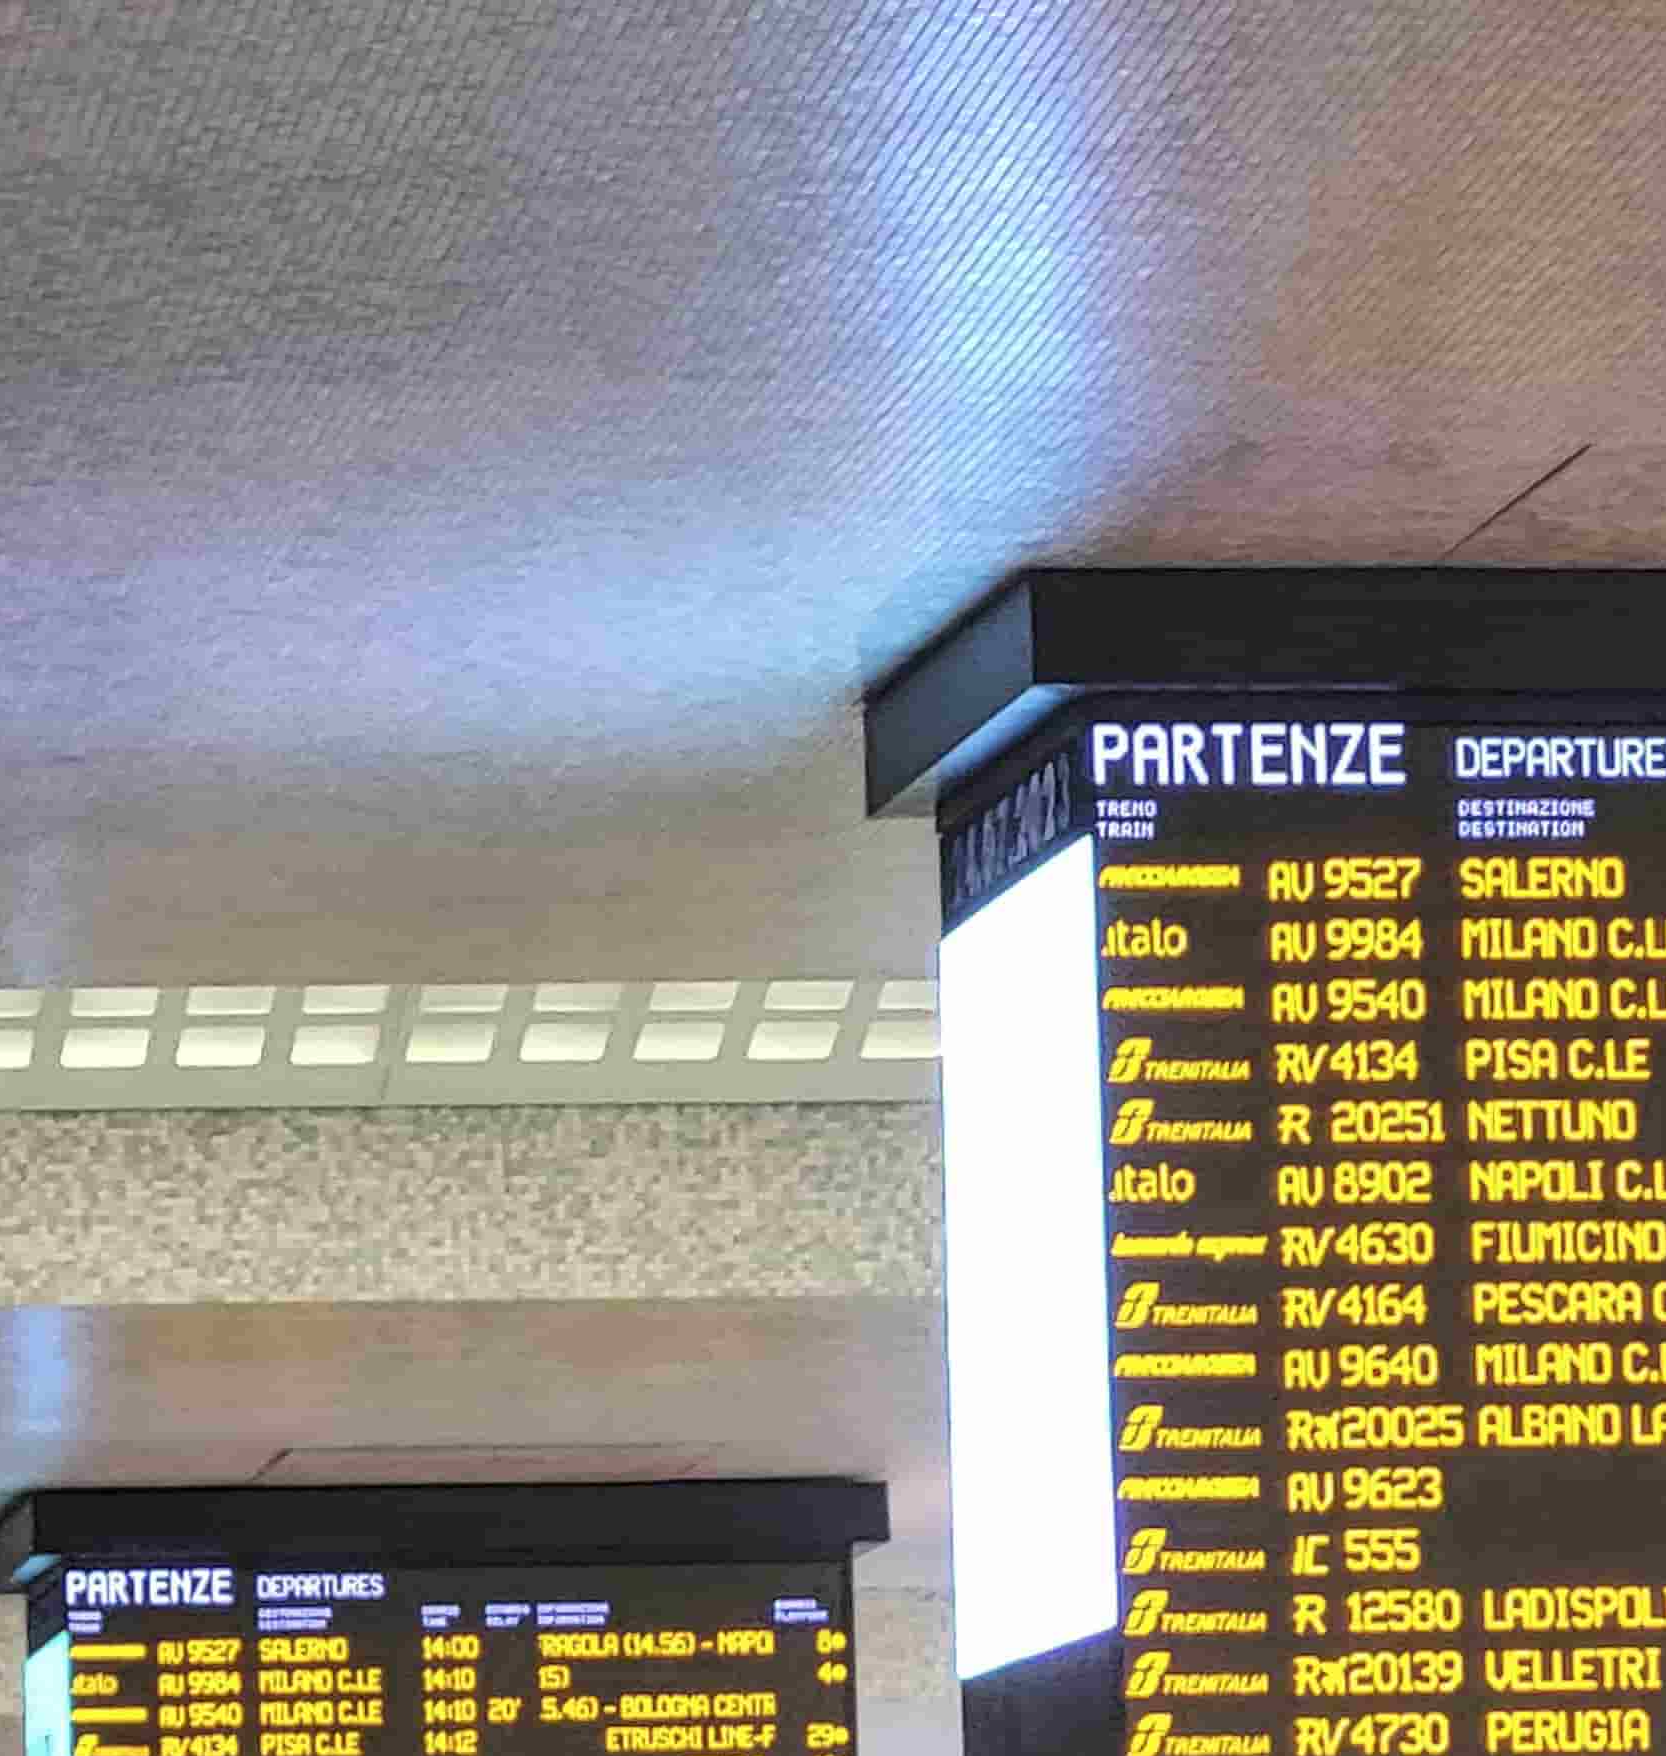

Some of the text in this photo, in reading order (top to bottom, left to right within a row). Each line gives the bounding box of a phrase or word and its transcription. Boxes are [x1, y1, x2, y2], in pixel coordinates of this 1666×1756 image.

[1093, 723, 1405, 785] PARTENZE
[1096, 821, 1154, 838] TRAIN
[1458, 819, 1585, 837] DESTINATION
[1458, 799, 1596, 817] DESTINAZIONE
[1269, 863, 1313, 901] AV
[1325, 859, 1420, 898] 9527
[1461, 858, 1623, 897] SALERNO
[1272, 923, 1316, 961] AV
[1326, 919, 1422, 959] 9984
[1463, 918, 1597, 958] MILANO
[1273, 984, 1317, 1022] AV
[1328, 980, 1425, 1020] 9540
[1464, 979, 1598, 1019] MILANO
[1330, 1040, 1417, 1082] 4134
[1467, 1040, 1557, 1080] PISA
[1569, 1039, 1650, 1079] C.LE
[1278, 1105, 1310, 1144] R
[1332, 1101, 1445, 1141] 20251
[1469, 1100, 1635, 1140] NETTUNO
[1279, 1167, 1323, 1205] AV
[1334, 1162, 1431, 1202] 8902
[1471, 1161, 1603, 1200] NAPOLI
[1335, 1223, 1433, 1265] 4630
[1472, 1221, 1666, 1262] FIUMICINO
[1337, 1284, 1426, 1327] 4164
[1474, 1282, 1642, 1323] PESCARA
[1285, 1350, 1329, 1388] AV
[1340, 1346, 1437, 1386] 9640
[1476, 1343, 1611, 1384] MILANO
[1341, 1406, 1463, 1449] 20025
[1479, 1404, 1621, 1445] ALBANO
[1289, 1472, 1333, 1511] AV
[1343, 1467, 1442, 1508] 9623
[1292, 1536, 1329, 1574] IC
[1345, 1529, 1419, 1570] 555
[67, 1569, 384, 1604] PARTENZE DEPARTURES
[1293, 1595, 1325, 1633] R
[1347, 1590, 1461, 1632] 12580
[258, 1636, 479, 1662] SALERNO 14:00
[259, 1670, 332, 1693] MILANO
[1348, 1651, 1462, 1695] 20139
[1486, 1648, 1661, 1690] VELLETRI
[1350, 1713, 1448, 1756] 4730
[1488, 1710, 1649, 1752] PERUGIA
